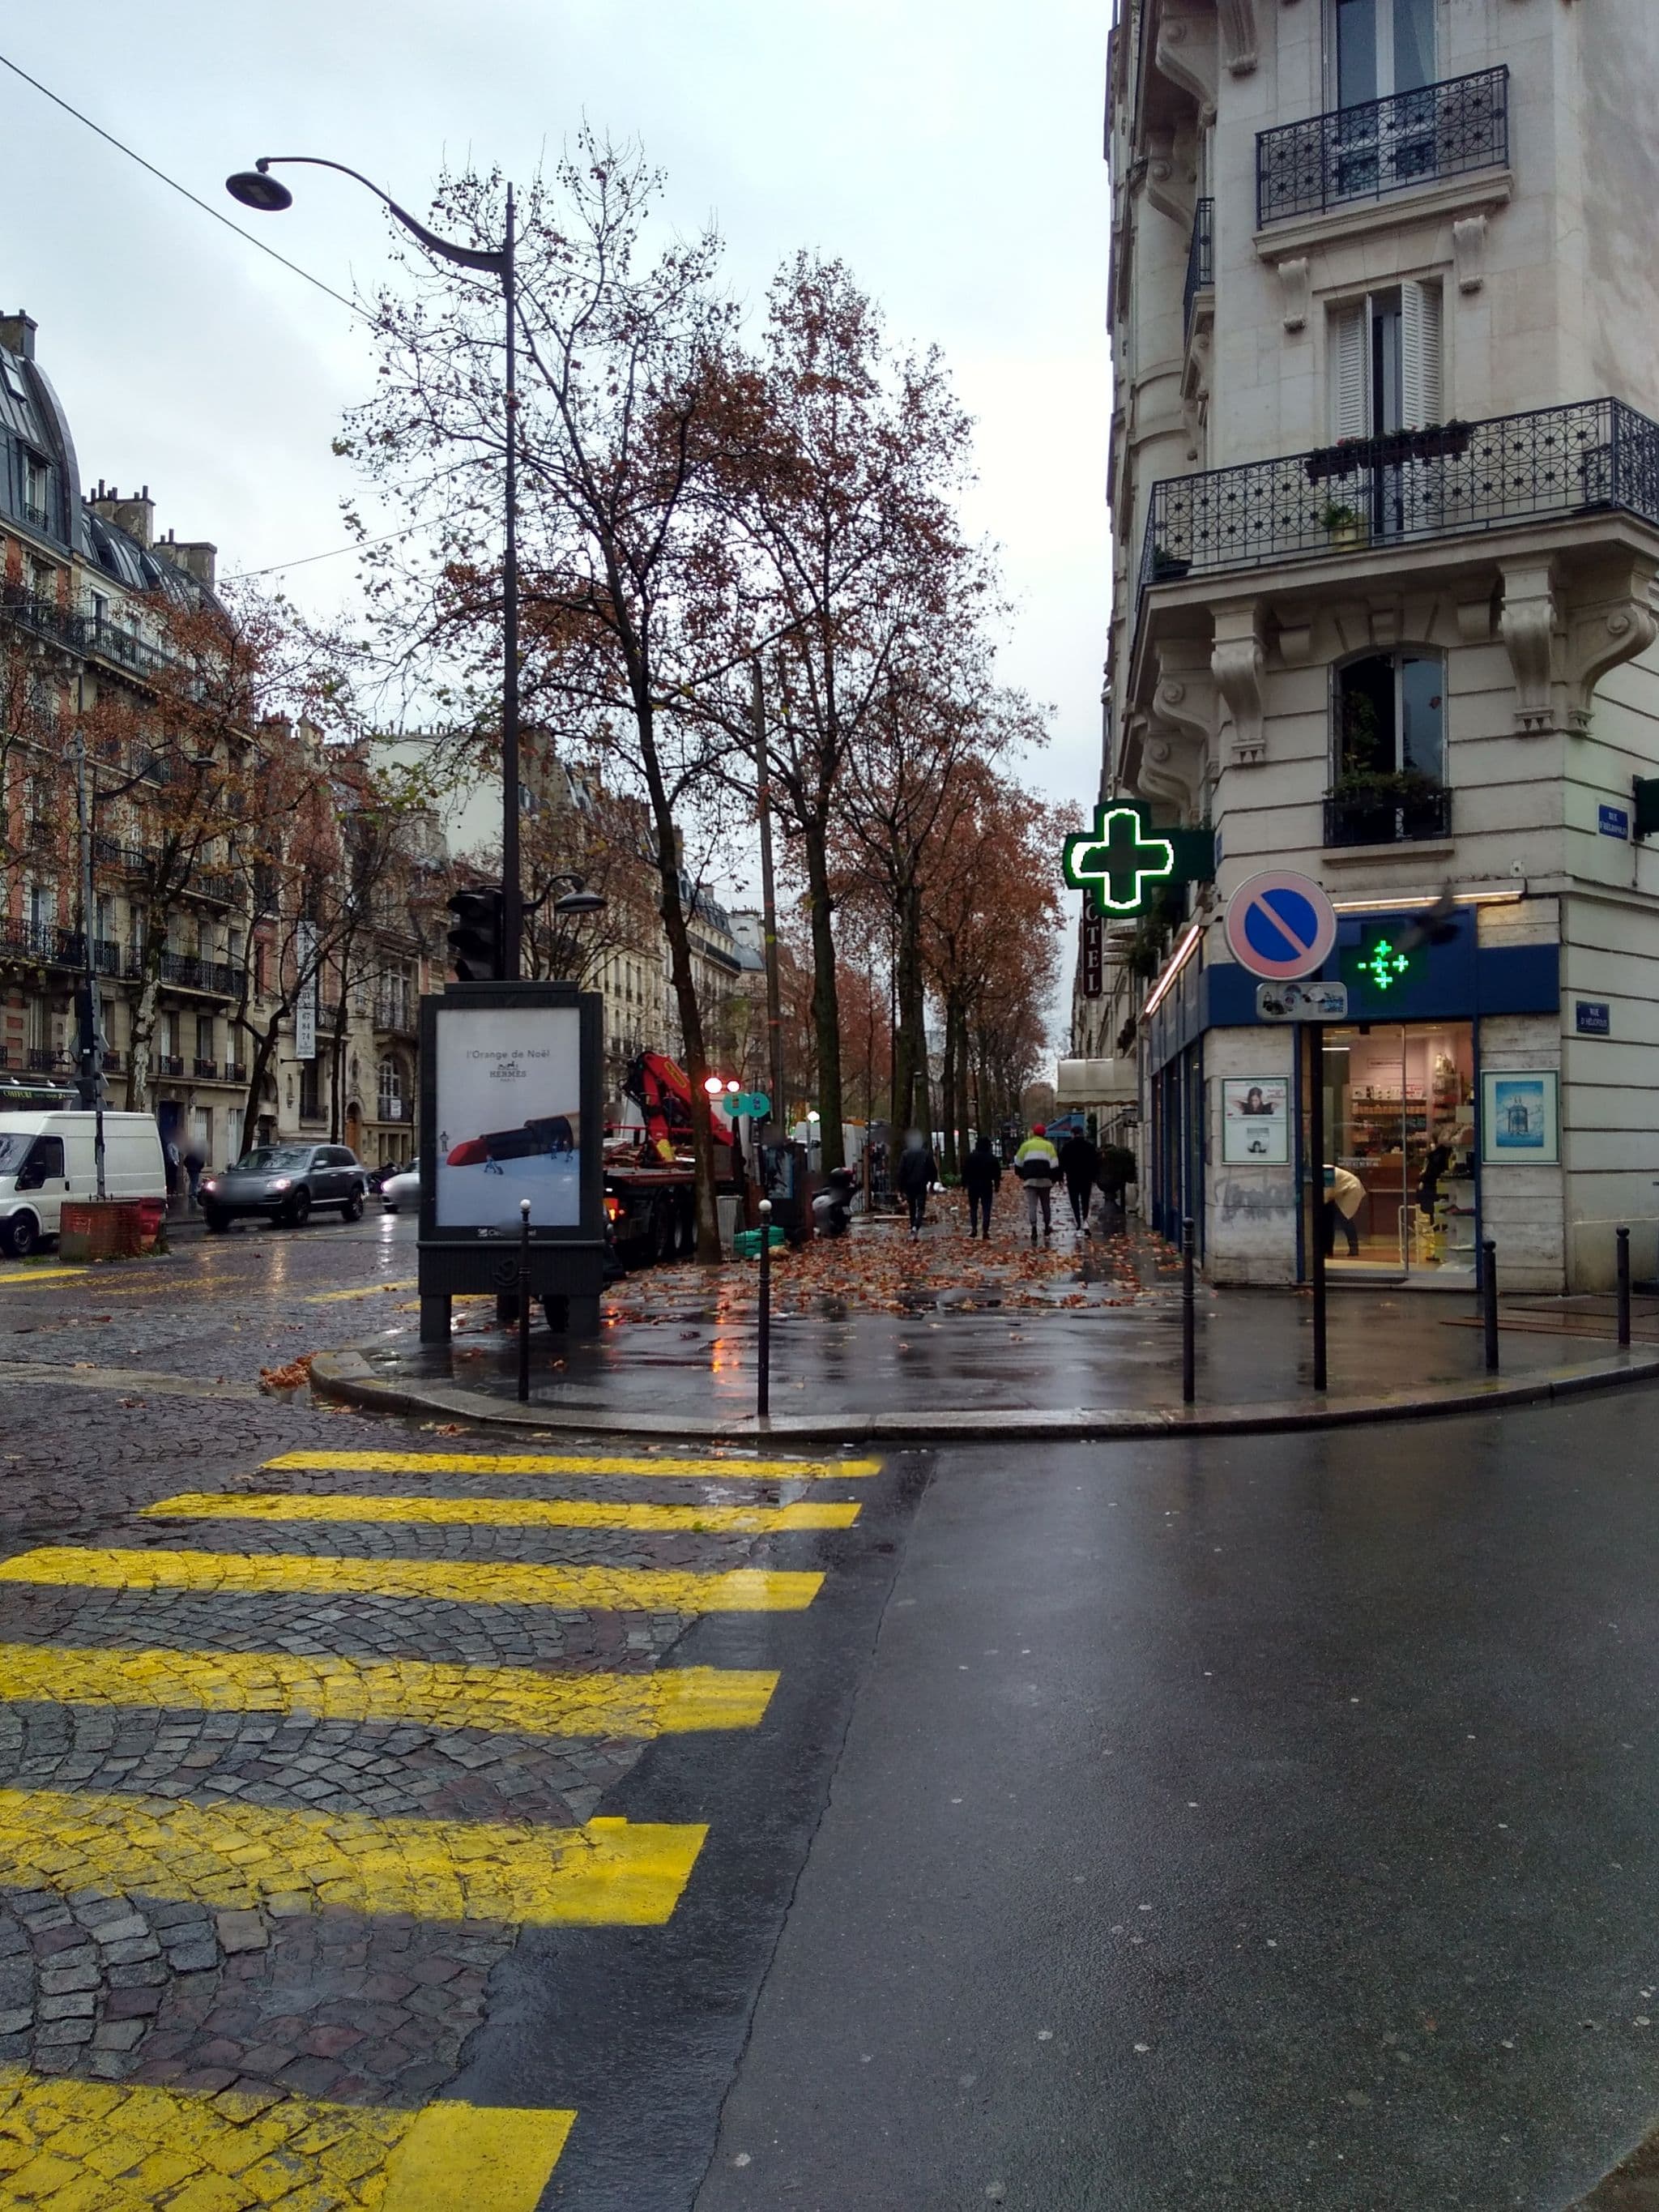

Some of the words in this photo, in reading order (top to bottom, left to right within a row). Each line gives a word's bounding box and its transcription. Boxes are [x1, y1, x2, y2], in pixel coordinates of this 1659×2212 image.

[1085, 889, 1099, 992] OTEL
[1589, 1008, 1600, 1016] RUE
[511, 1049, 524, 1058] de
